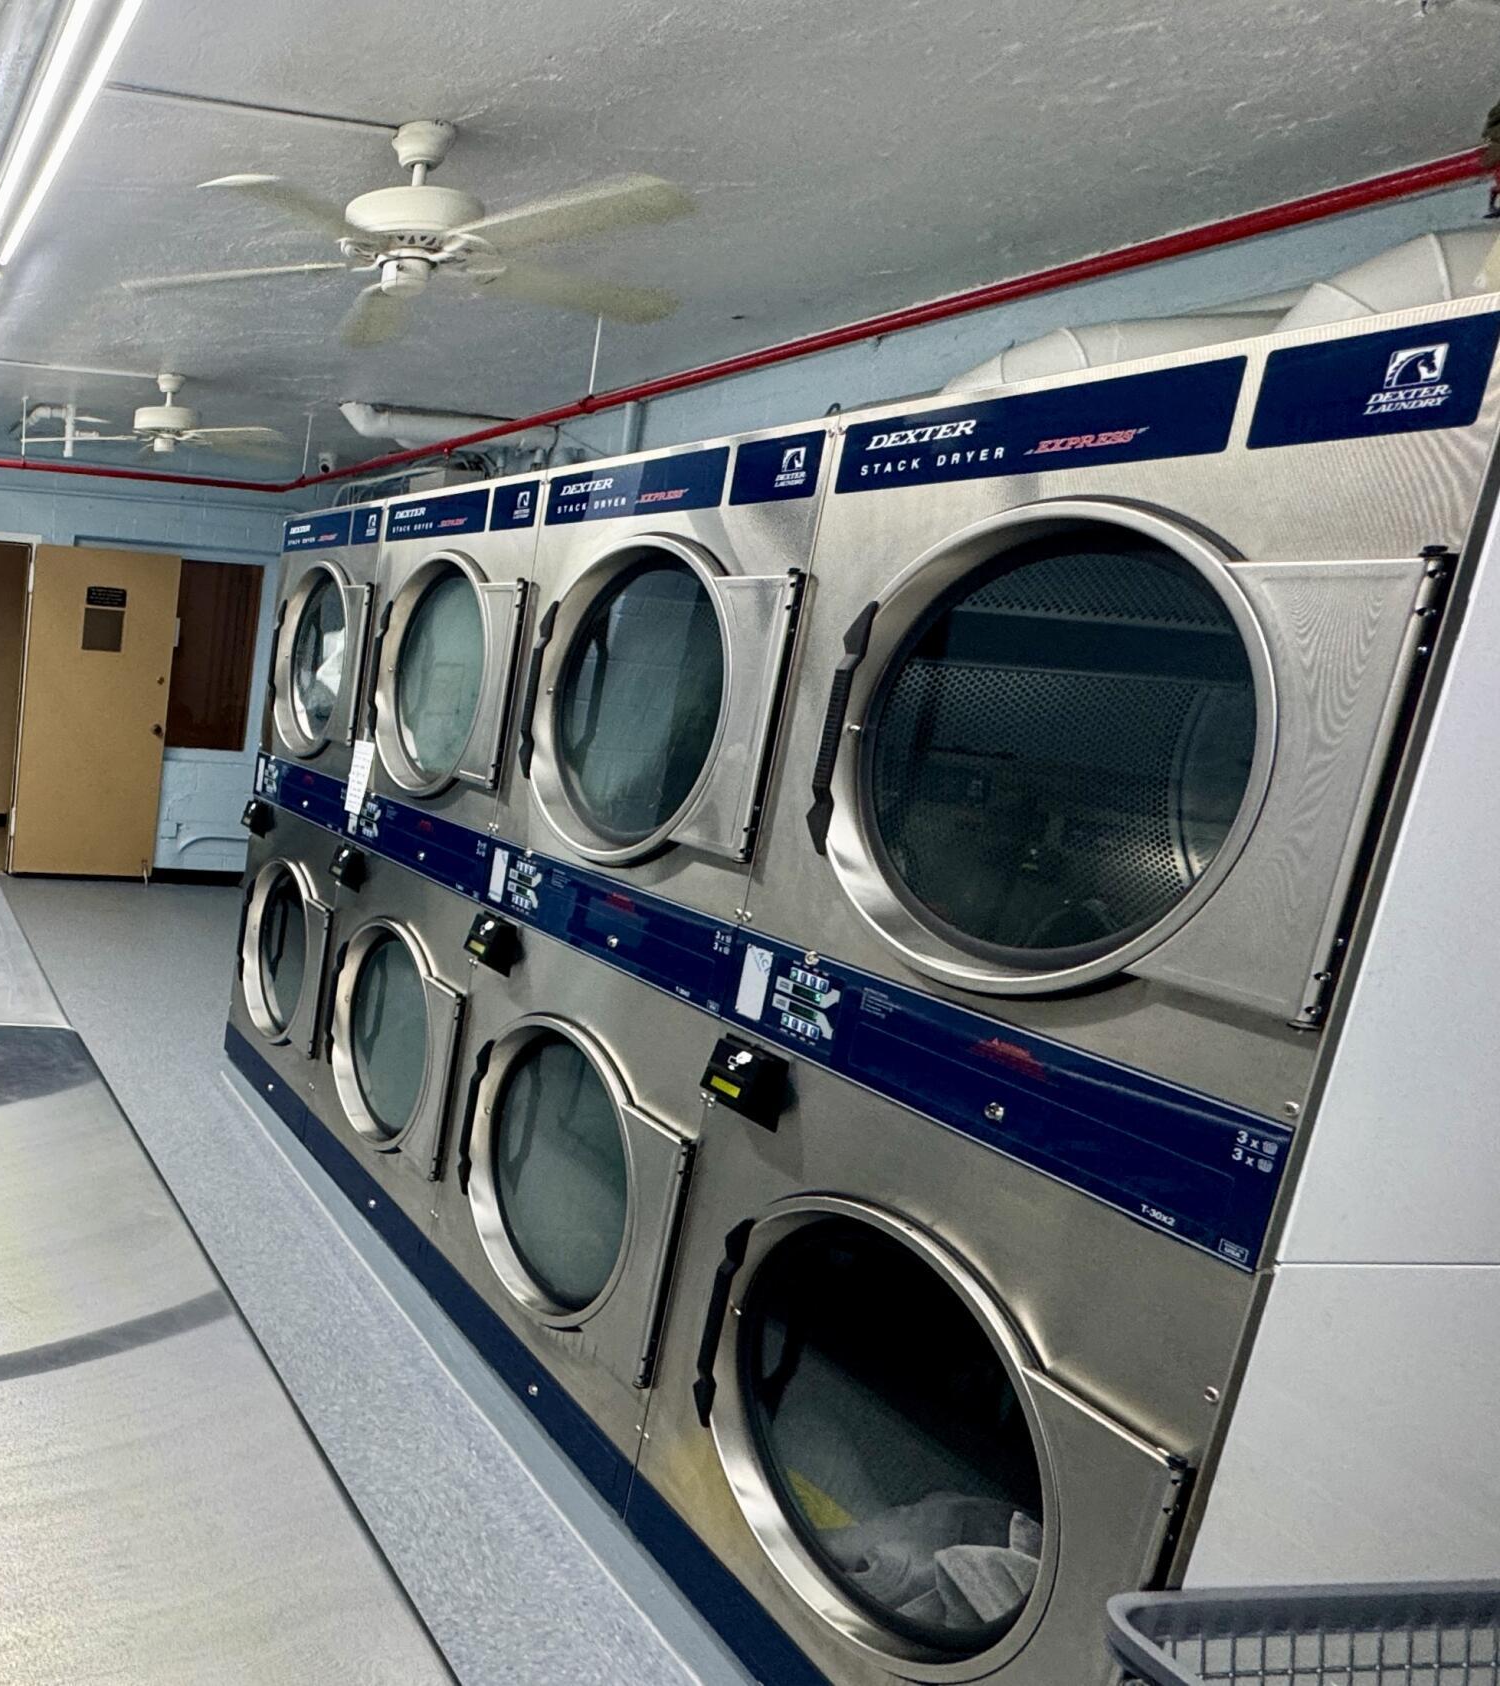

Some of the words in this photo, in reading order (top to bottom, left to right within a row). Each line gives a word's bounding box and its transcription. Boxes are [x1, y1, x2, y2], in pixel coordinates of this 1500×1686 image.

[1365, 385, 1450, 405] DEXTER
[1363, 396, 1449, 415] LAUNDRY
[865, 420, 977, 450] DEXTER
[1034, 429, 1140, 454] EXPRESS
[861, 458, 920, 476] STACK
[937, 447, 1005, 467] DRYER
[560, 478, 614, 496] DEXTER
[394, 507, 426, 520] DEXTER
[557, 503, 587, 514] STACK
[593, 497, 627, 510] DRYER
[1236, 1130, 1249, 1144] 3
[1250, 1139, 1260, 1149] x
[1231, 1147, 1243, 1161] 3
[1245, 1156, 1254, 1167] x
